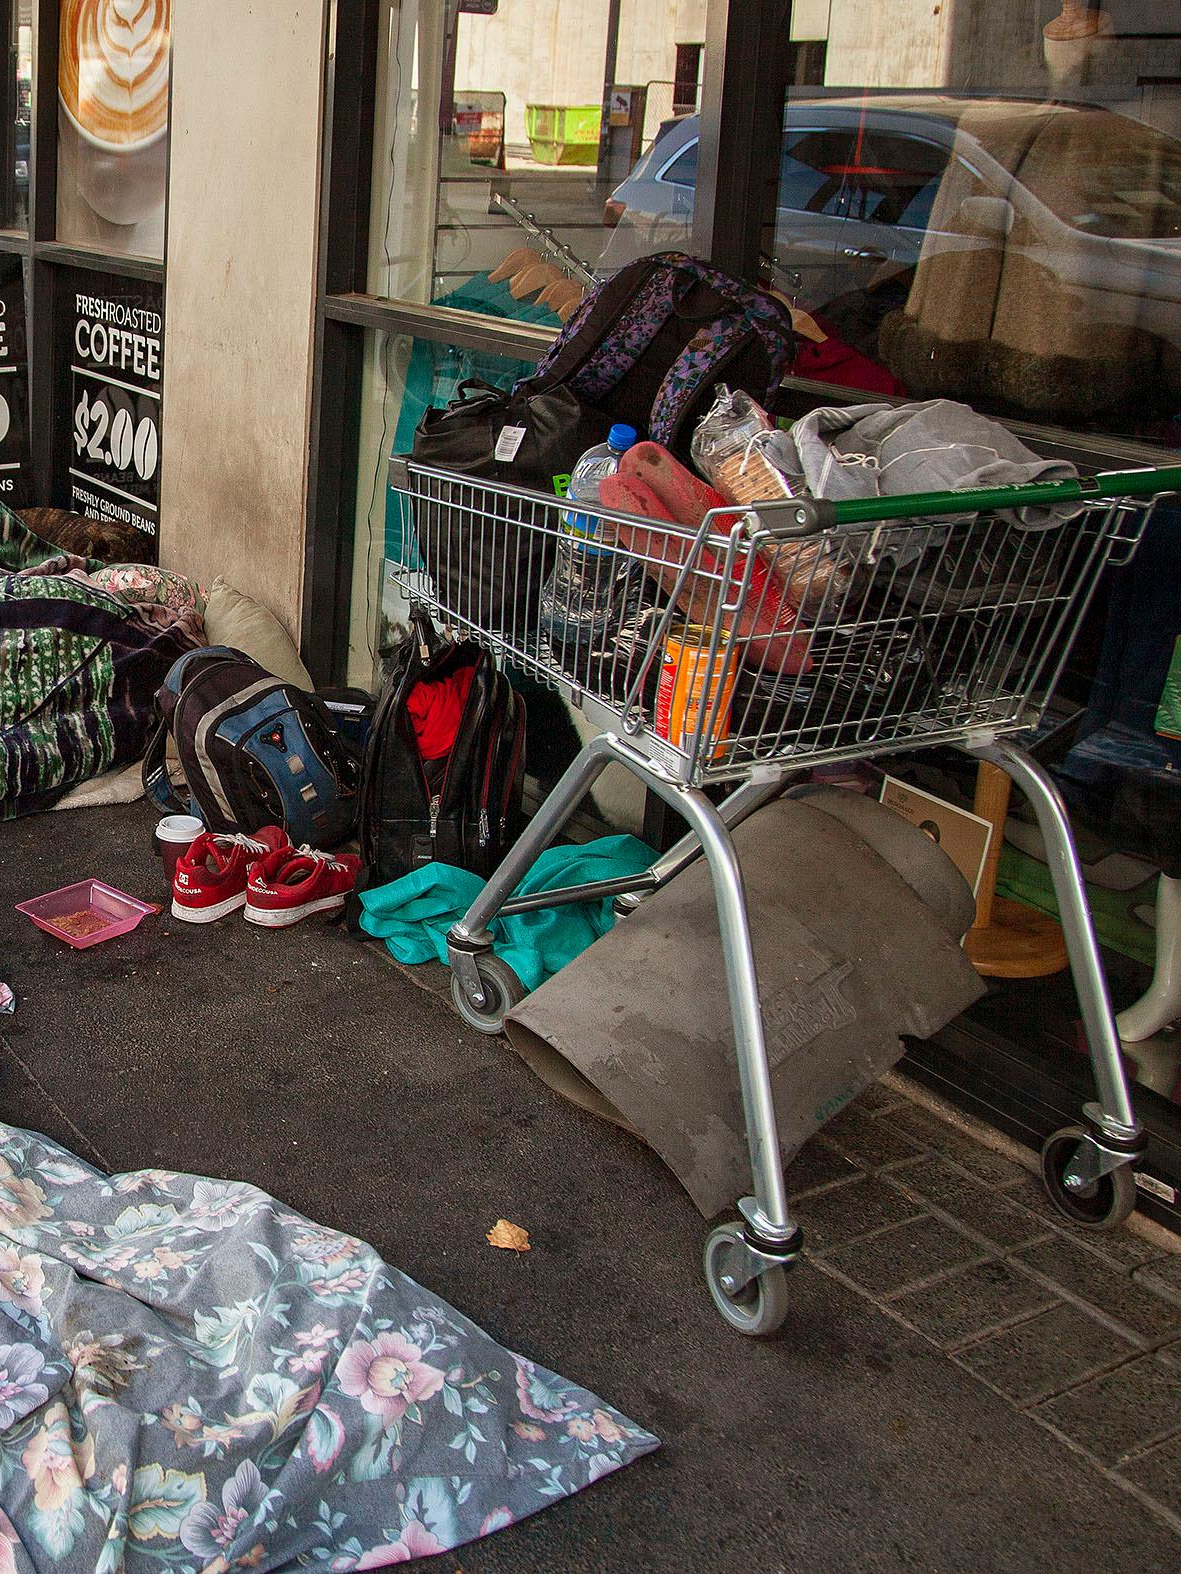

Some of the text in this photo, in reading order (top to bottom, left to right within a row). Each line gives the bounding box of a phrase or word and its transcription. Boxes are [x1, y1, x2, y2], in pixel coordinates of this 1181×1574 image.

[76, 293, 161, 333] FRESHROASTED
[75, 318, 160, 380] COFFEE
[73, 389, 158, 480] $2.00
[72, 485, 156, 536] FRESHLY GROUND BEANS
